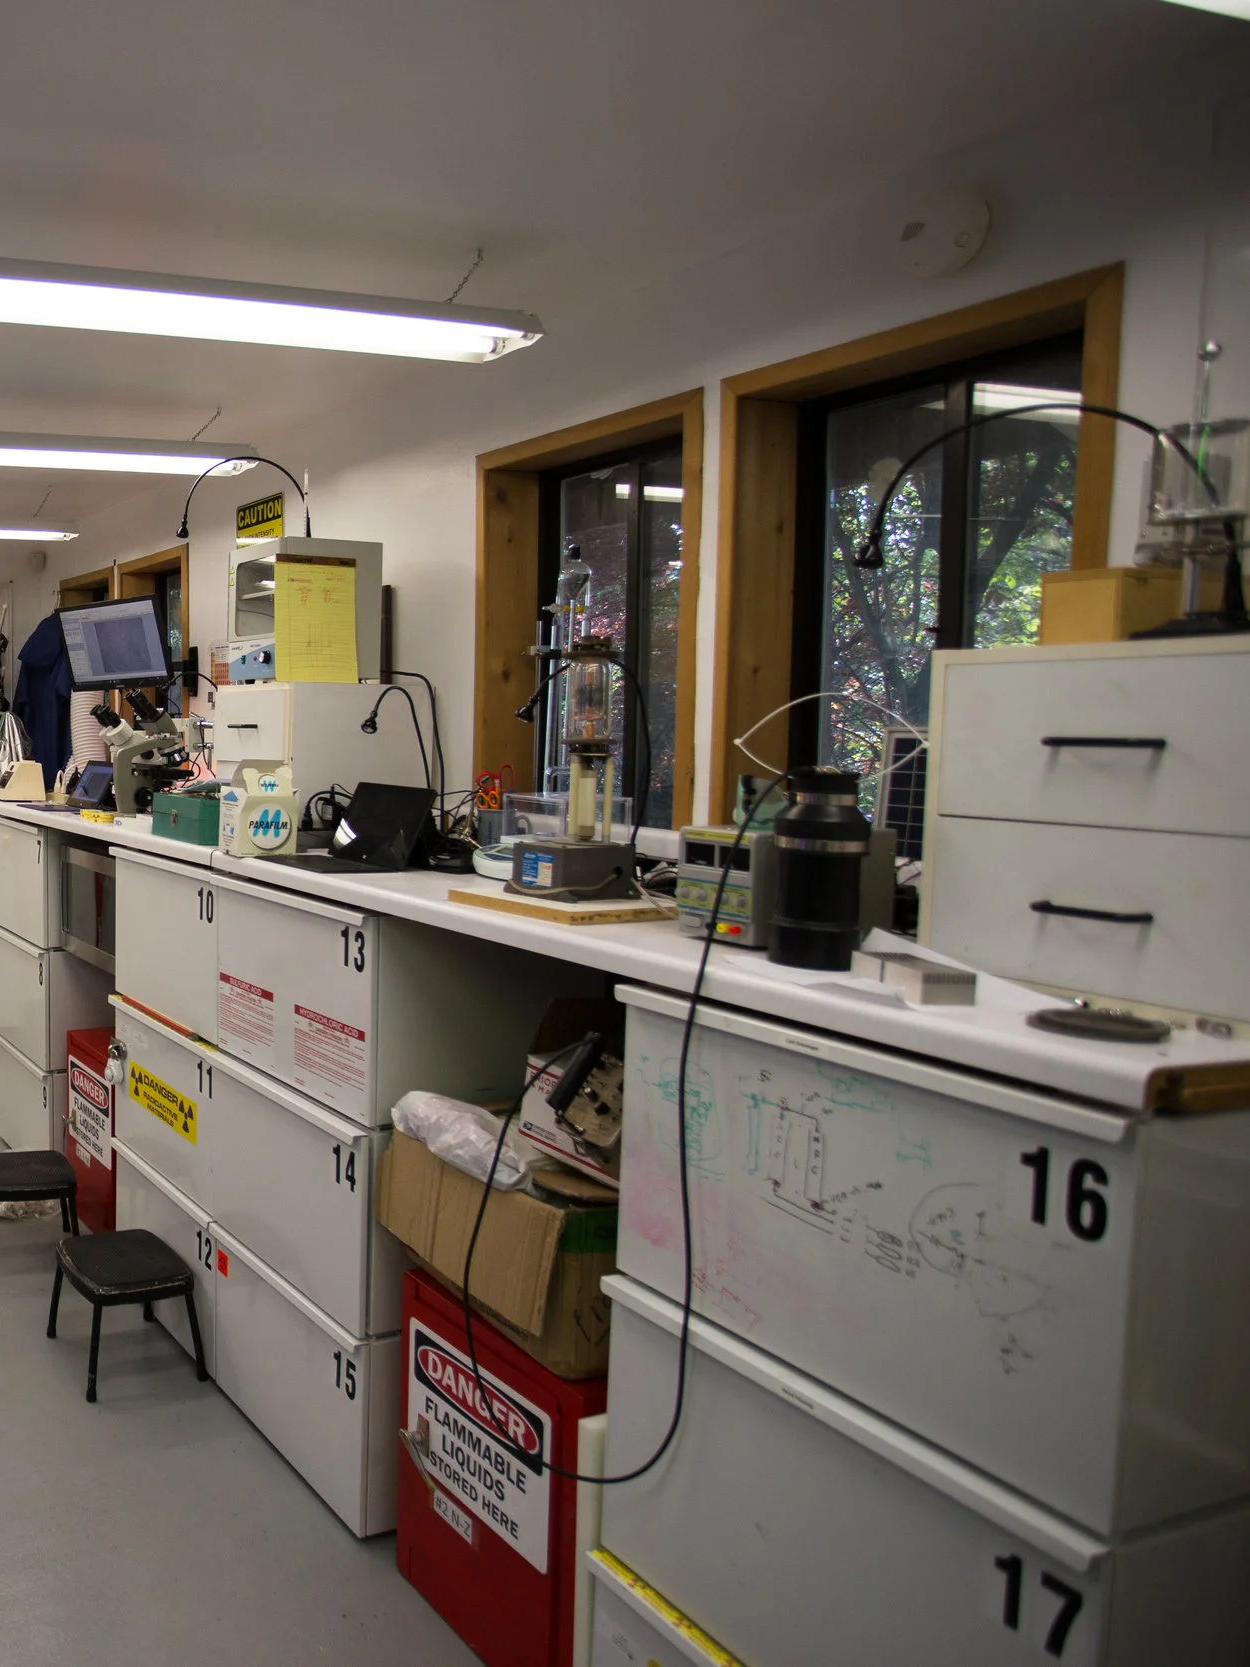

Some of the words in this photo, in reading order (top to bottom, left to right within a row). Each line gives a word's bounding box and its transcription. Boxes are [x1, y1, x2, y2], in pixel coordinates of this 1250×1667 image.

[238, 498, 282, 528] CAUTION
[248, 820, 288, 830] PARAFILM
[197, 886, 214, 923] 10
[340, 925, 366, 973] 13
[38, 962, 44, 987] 8
[229, 977, 250, 992] SULFURIC
[250, 986, 262, 997] ACID
[299, 1008, 343, 1032] HYDROCHLORIC
[343, 1025, 359, 1038] ACID
[42, 1085, 48, 1110] 9
[74, 1070, 105, 1107] DANGER
[143, 1074, 179, 1107] DANGER
[197, 1060, 213, 1099] 11
[74, 1097, 106, 1131] FLAMMABLE
[143, 1091, 178, 1122] RADIOACTIVE
[147, 1103, 175, 1128] MATERIALS
[79, 1115, 100, 1141] LIQUIDS
[91, 1140, 104, 1158] HERE
[332, 1143, 357, 1193] 14
[1020, 1146, 1110, 1243] 16
[196, 1230, 212, 1271] 12
[333, 1350, 357, 1401] 15
[427, 1350, 527, 1448] DANGER
[425, 1395, 527, 1495] FLAMMABLE
[441, 1433, 505, 1502] LIQUIDS
[429, 1450, 478, 1502] STORED
[481, 1494, 519, 1540] HERE
[993, 1552, 1084, 1660] 17
